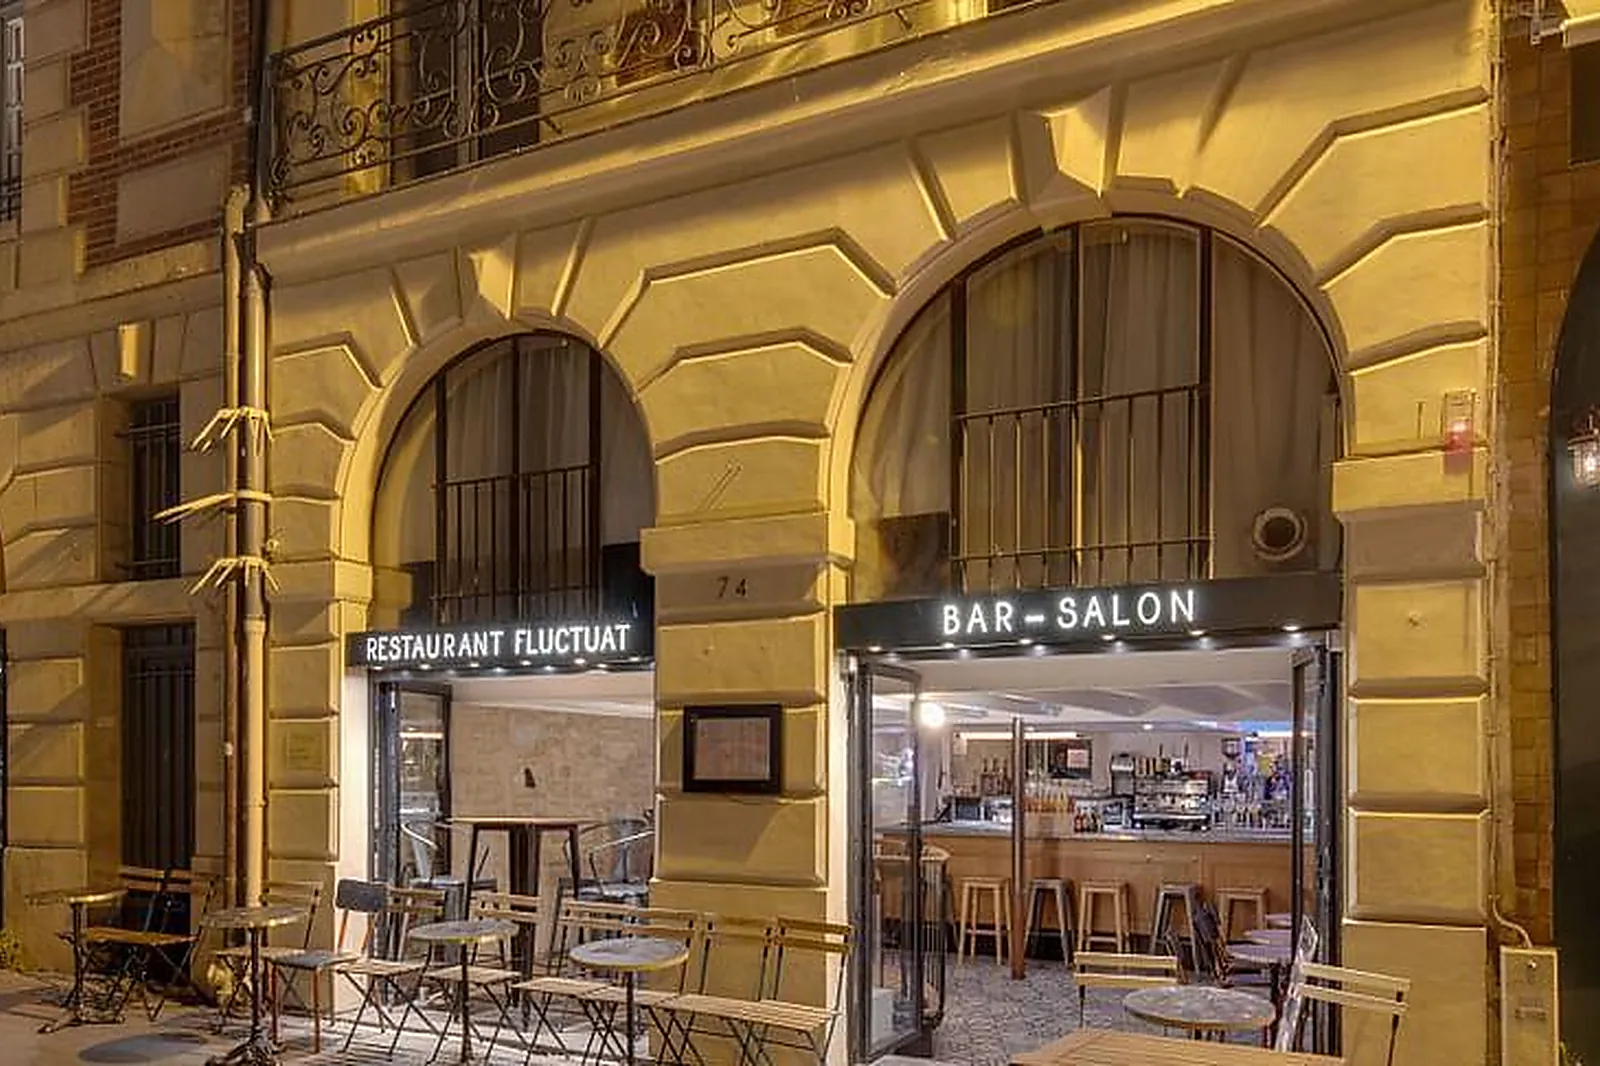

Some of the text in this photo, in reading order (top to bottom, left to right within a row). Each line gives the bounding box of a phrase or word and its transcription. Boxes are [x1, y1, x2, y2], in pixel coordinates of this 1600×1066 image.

[716, 576, 747, 598] 74
[366, 624, 631, 661] RESTAURANT FLUCTUAT
